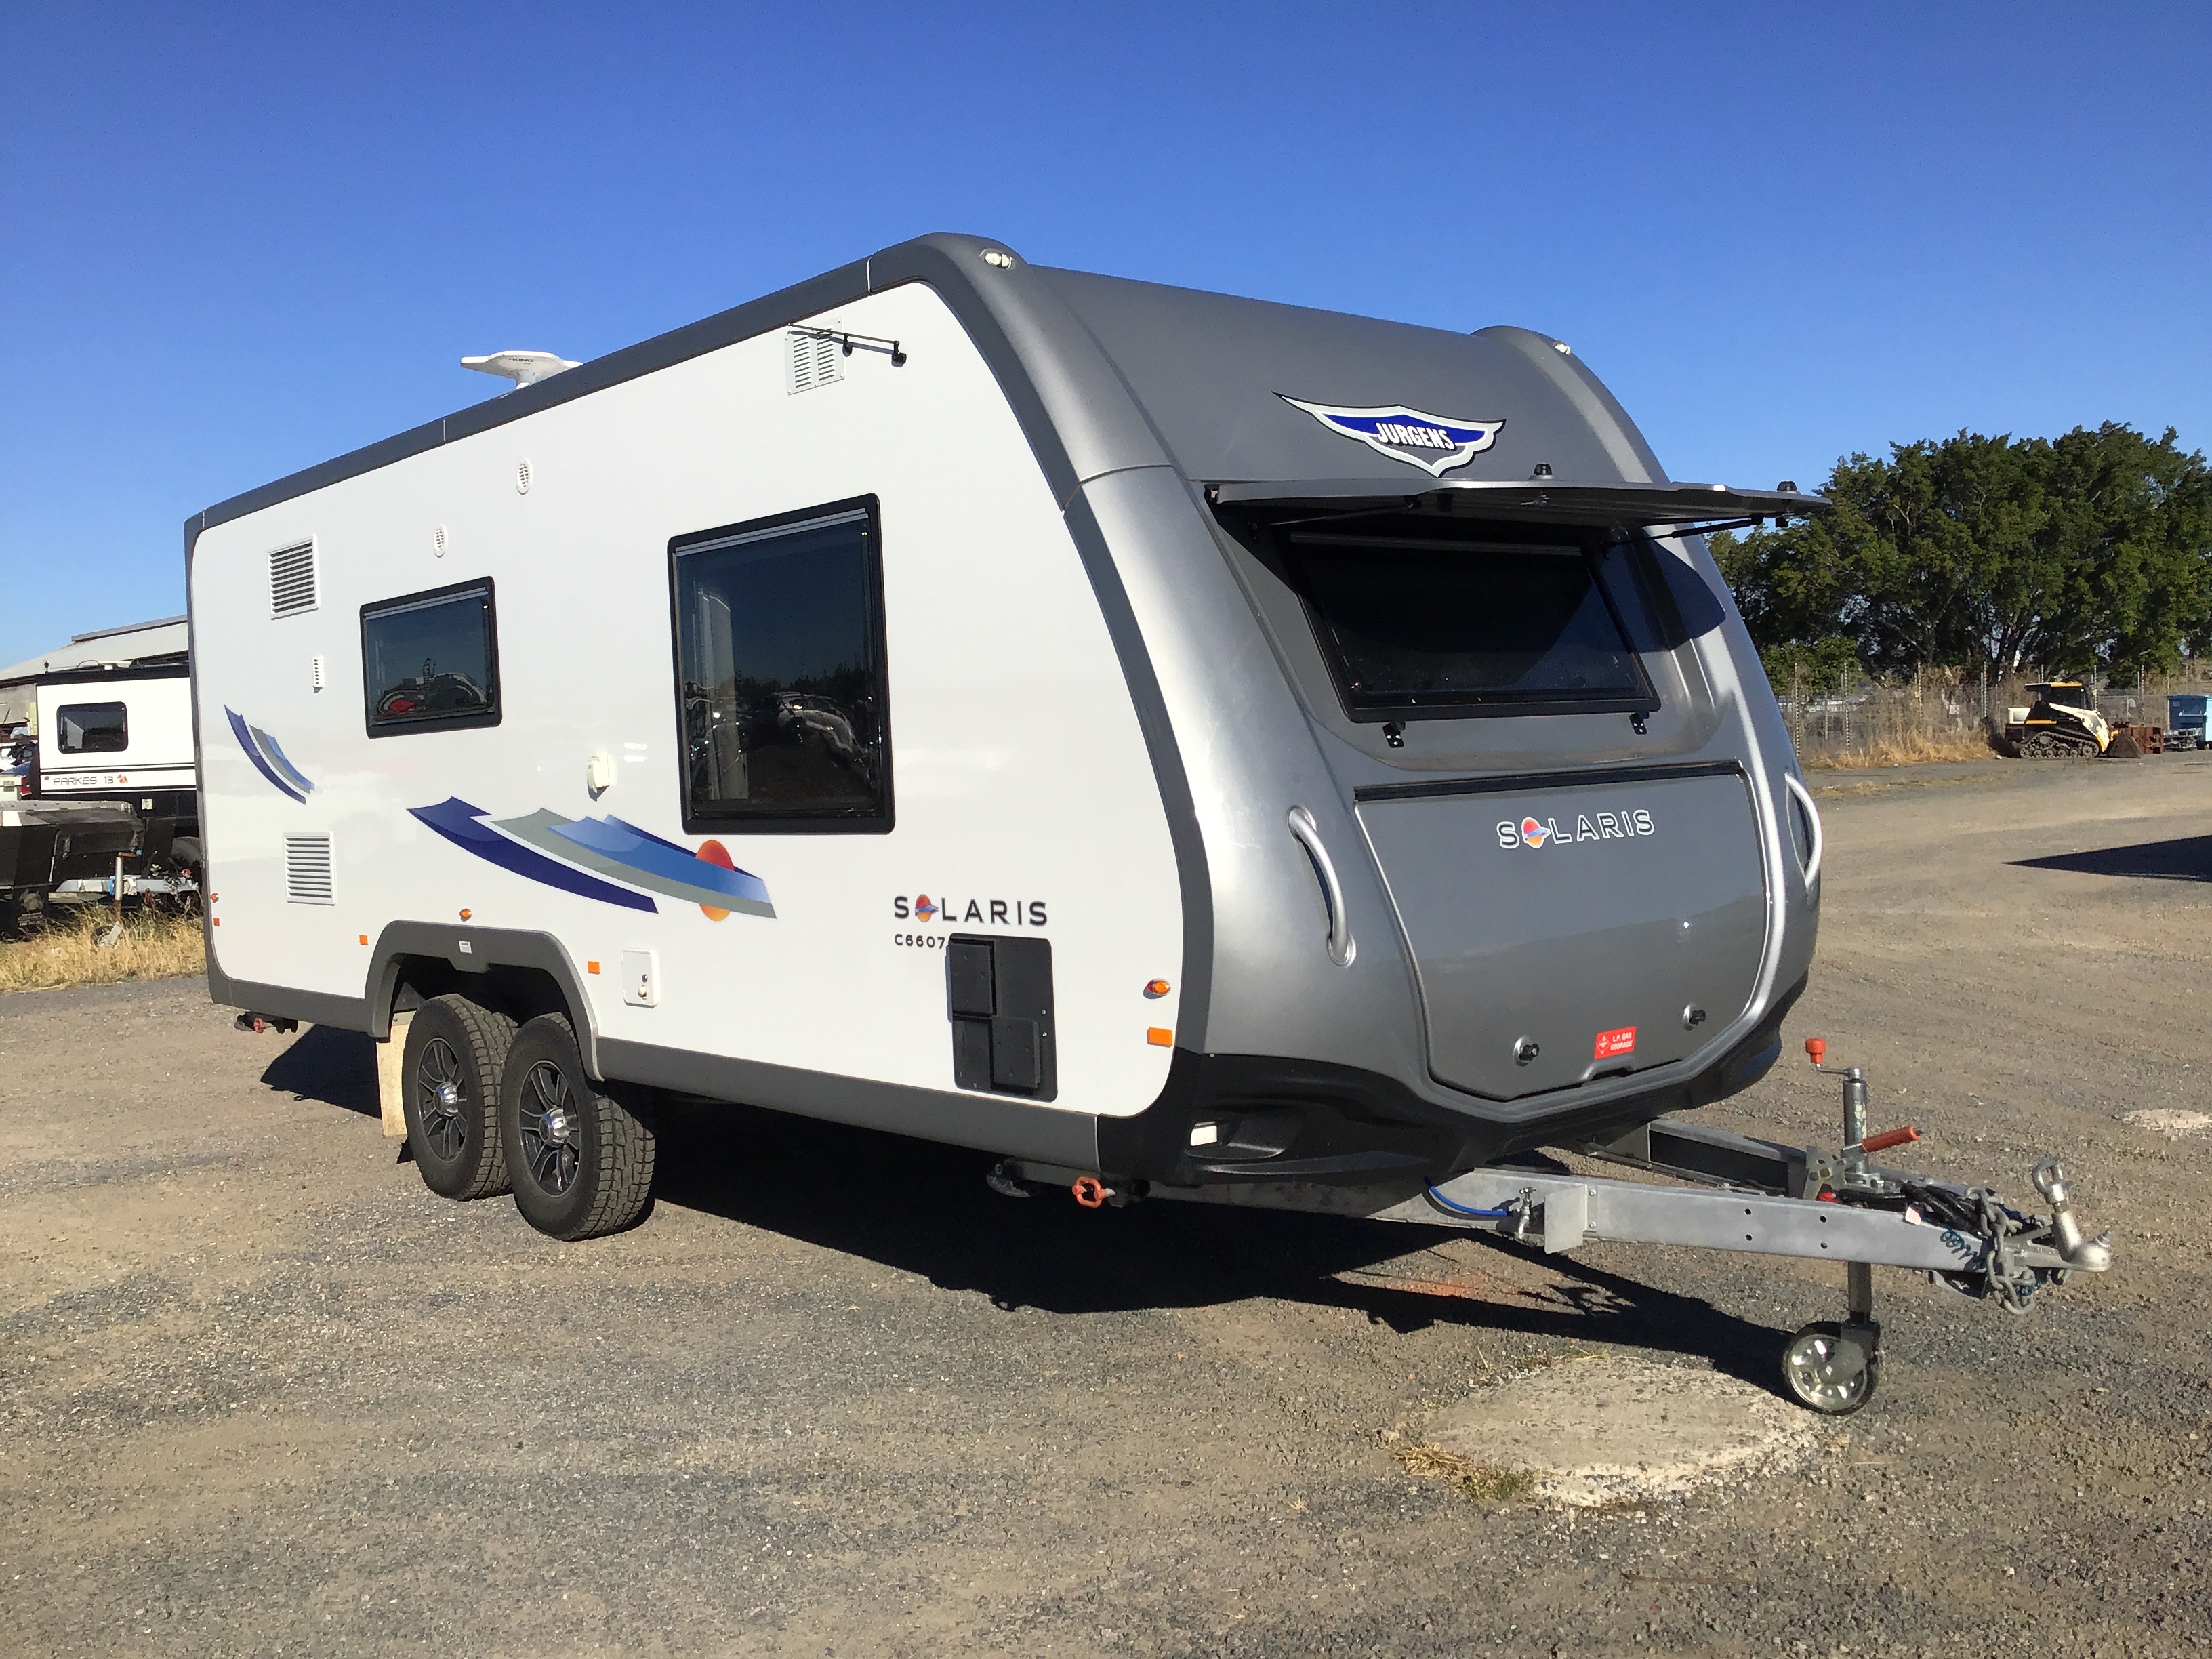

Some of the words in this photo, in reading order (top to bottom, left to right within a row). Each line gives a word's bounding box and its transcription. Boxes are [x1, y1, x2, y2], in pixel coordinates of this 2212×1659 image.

[1376, 422, 1456, 451] JURGENS
[53, 777, 97, 785] PARKES
[104, 776, 114, 784] 13
[1496, 809, 1655, 848] SOLARIS
[894, 894, 1048, 927] SOLARIS
[894, 933, 945, 949] C6607
[1622, 1031, 1632, 1040] GAS
[1610, 1040, 1633, 1051] STORAGE
